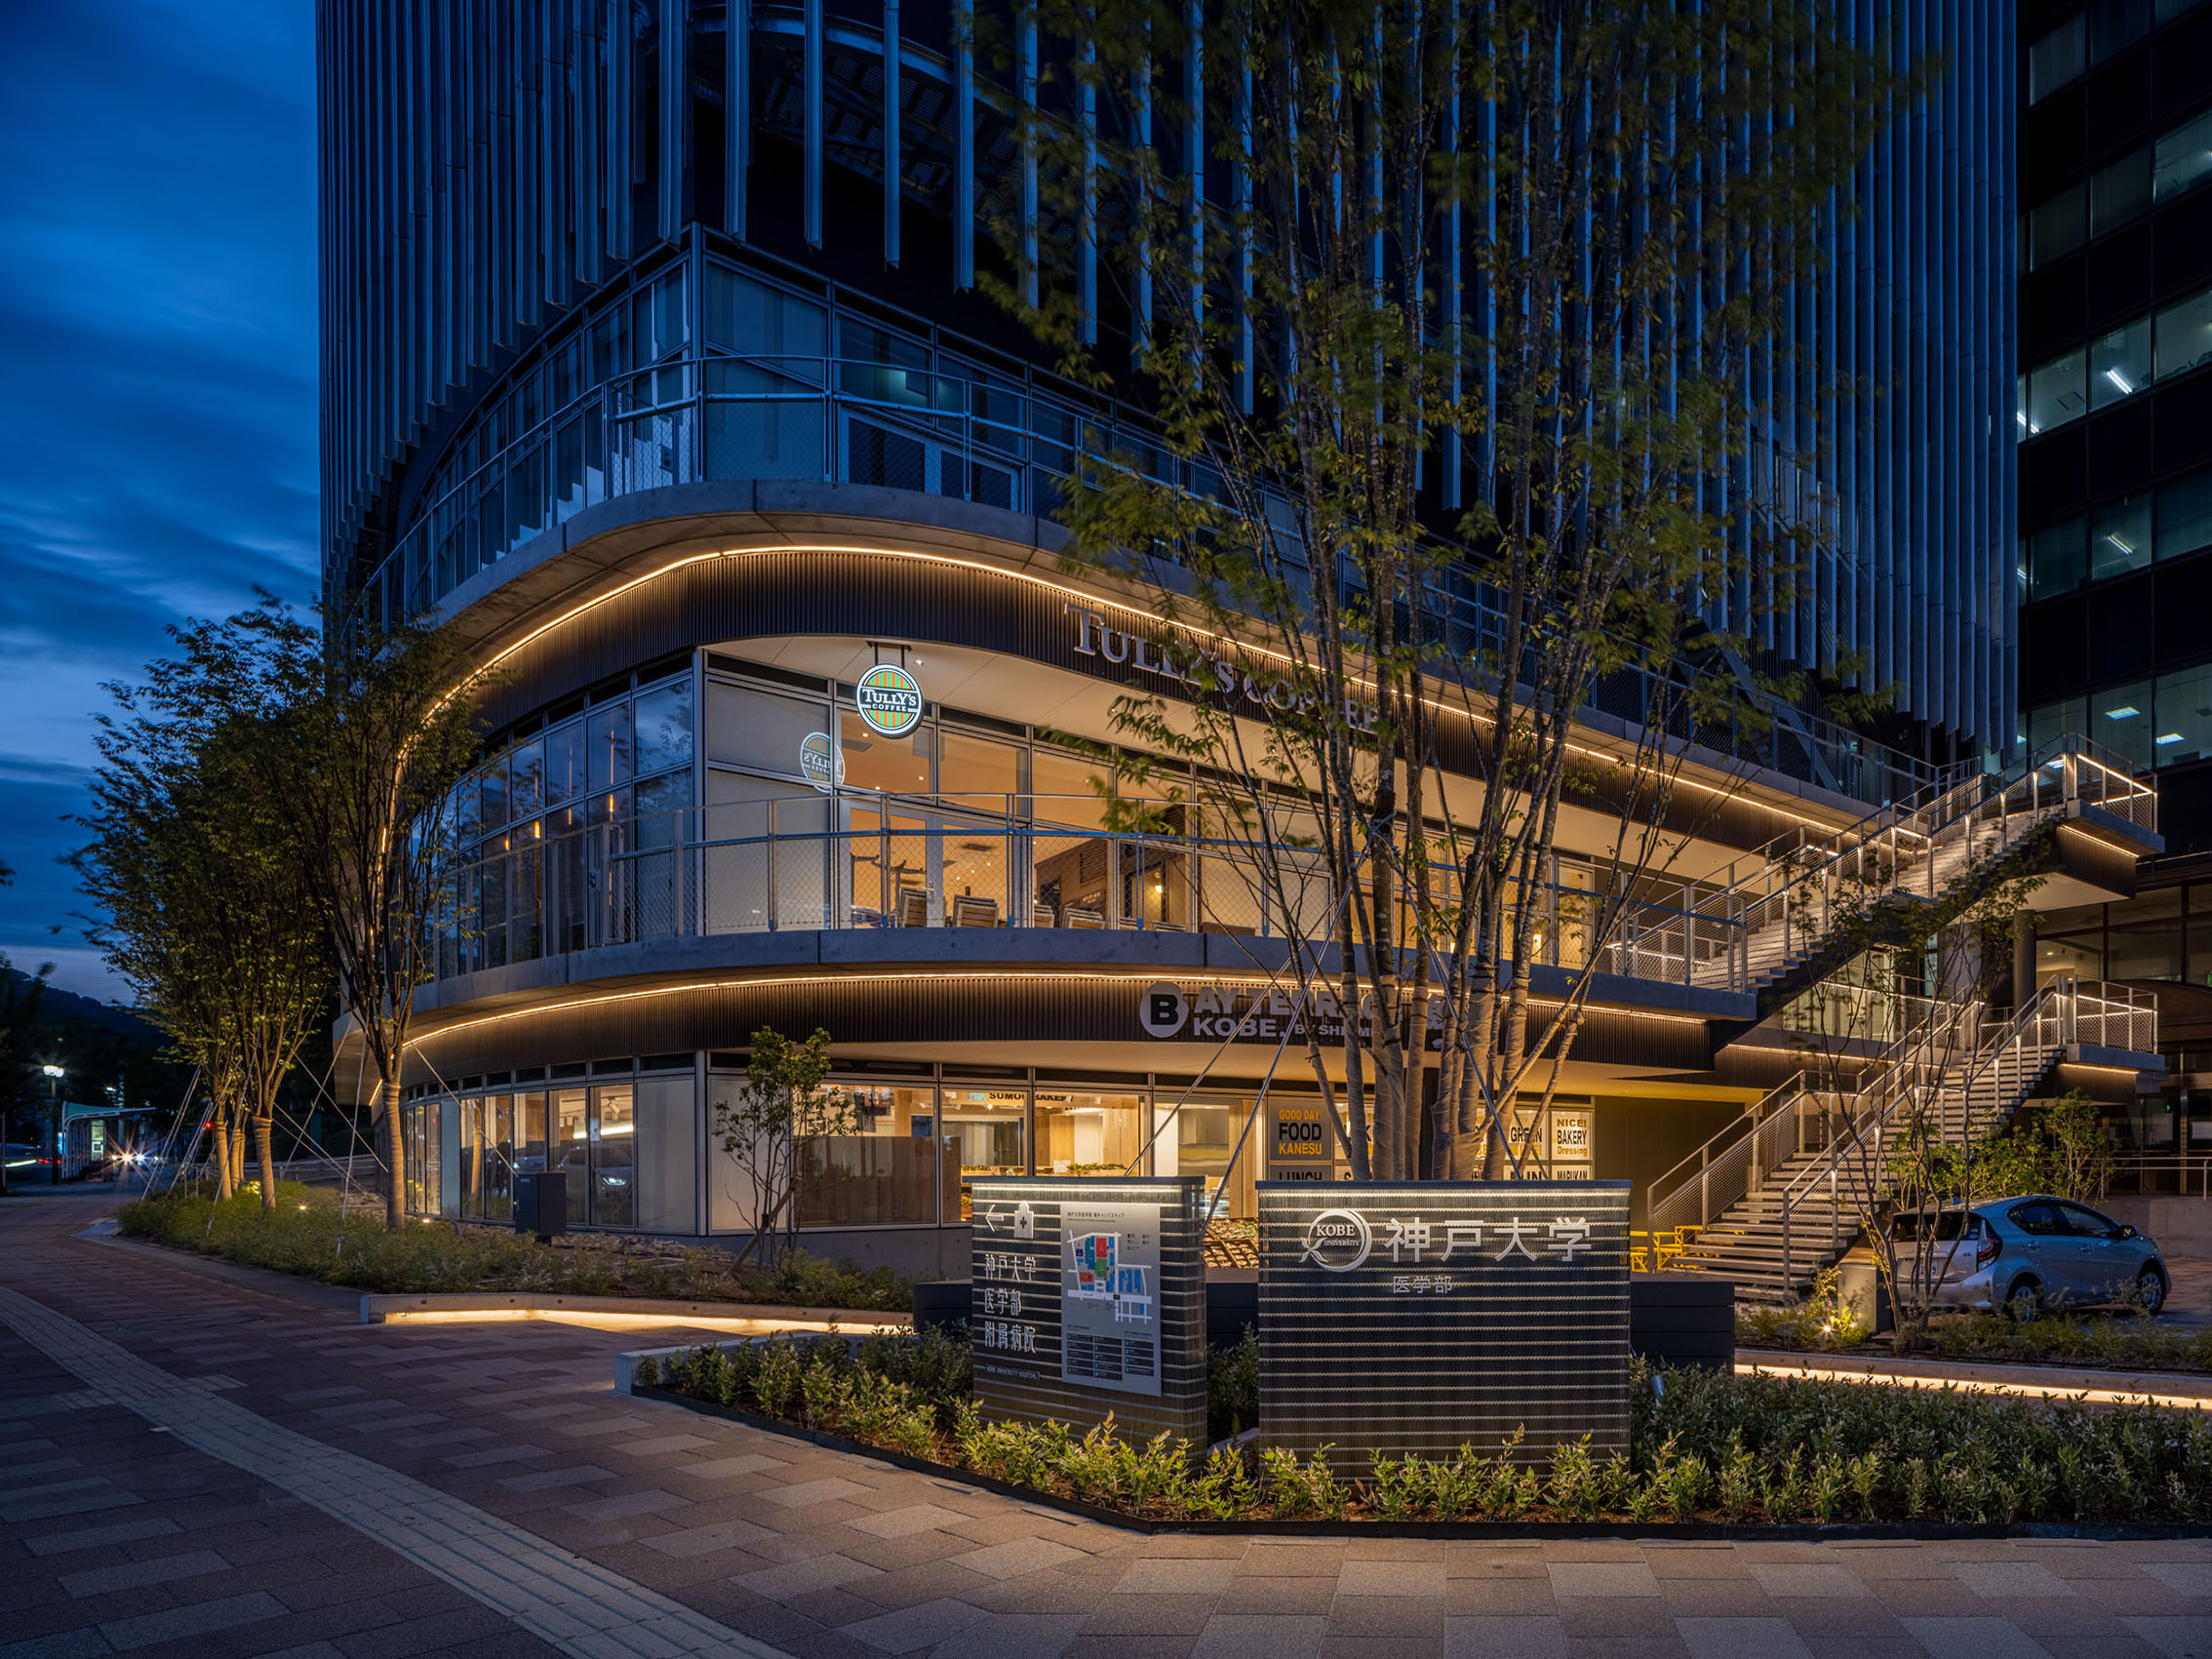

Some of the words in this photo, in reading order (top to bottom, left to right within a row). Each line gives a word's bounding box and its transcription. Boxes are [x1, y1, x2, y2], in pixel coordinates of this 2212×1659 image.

[862, 689, 917, 706] TULLY'S
[872, 703, 907, 712] COFFEE
[1279, 1109, 1302, 1121] GOOD
[1557, 1119, 1587, 1127] NICE!
[1279, 1123, 1322, 1141] FOOD
[1558, 1129, 1588, 1145] BAKERY
[1279, 1142, 1323, 1156] KANESU
[1558, 1146, 1588, 1156] Dressing
[1316, 1224, 1356, 1237] KOBE
[1384, 1216, 1593, 1263] 神戸大学
[984, 1253, 1036, 1283] 神戸大学
[1393, 1275, 1452, 1294] 医学部
[984, 1287, 1021, 1317] 医学部
[984, 1321, 1036, 1354] 附属病院
